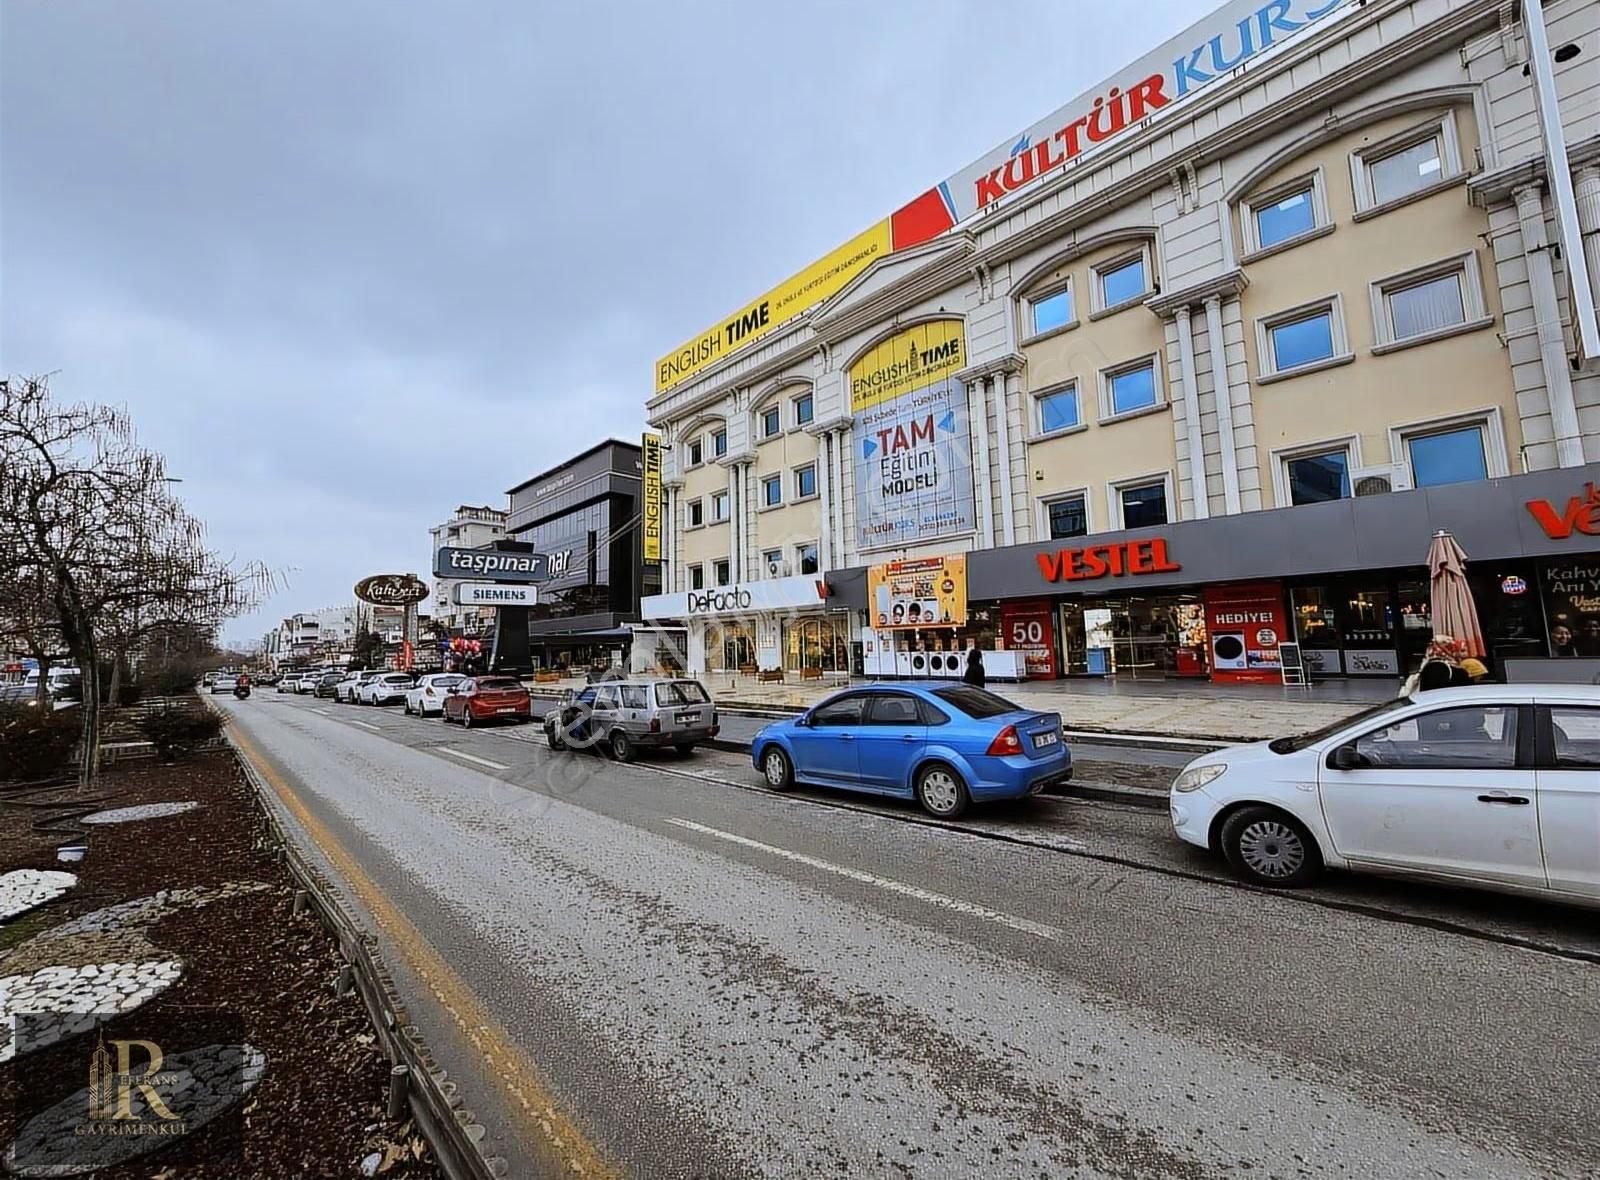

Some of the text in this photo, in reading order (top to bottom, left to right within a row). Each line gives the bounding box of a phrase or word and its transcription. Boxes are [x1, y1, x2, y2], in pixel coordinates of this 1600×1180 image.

[975, 73, 1172, 211] KÜLTÜR
[660, 301, 769, 384] ENGLISH TIME
[852, 358, 909, 394] ENGLISH
[920, 338, 959, 367] TIME
[877, 413, 935, 457] TAM
[646, 439, 659, 474] TIME
[646, 477, 659, 538] ENGLISH
[450, 551, 540, 574] taşpınar
[1036, 537, 1181, 583] VESTEL
[473, 588, 526, 600] SIEMENS
[688, 585, 751, 614] DeFacto
[1012, 621, 1042, 643] 50
[1215, 610, 1273, 624] HEDİYE!
